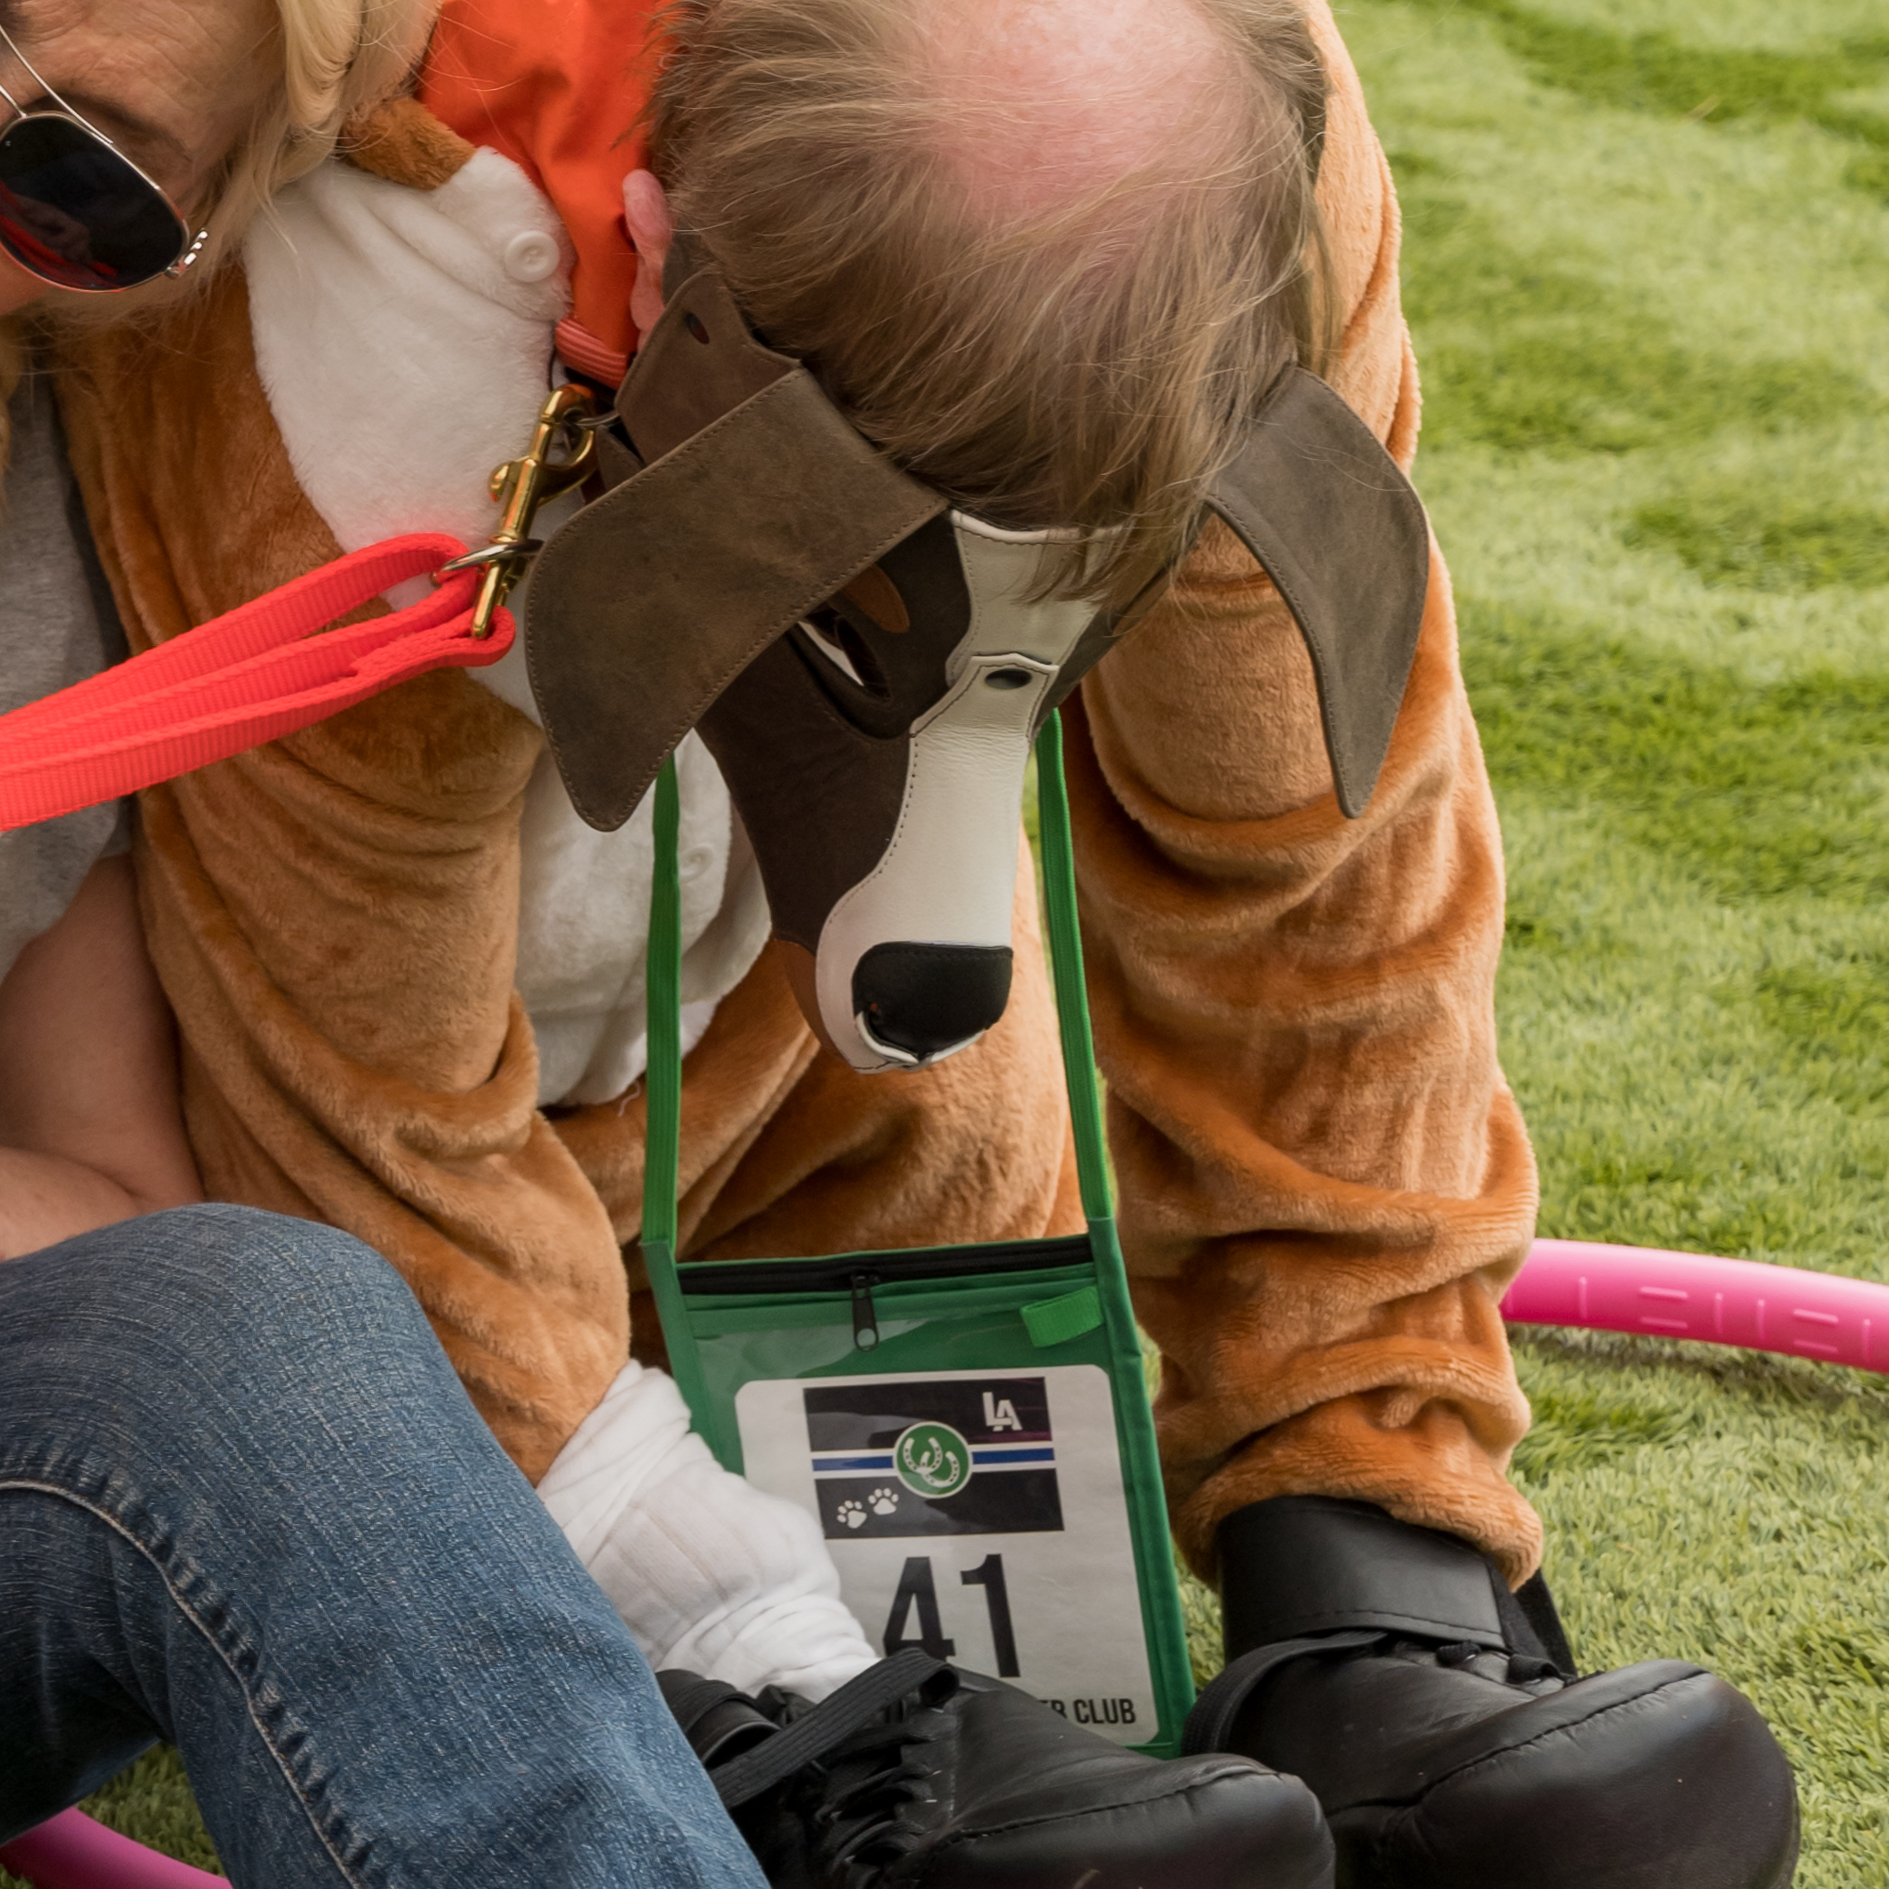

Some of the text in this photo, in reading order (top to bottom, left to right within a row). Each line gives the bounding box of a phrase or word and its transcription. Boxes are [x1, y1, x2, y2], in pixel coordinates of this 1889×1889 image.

[982, 1391, 1022, 1431] LA
[882, 1553, 1021, 1678] 41
[1073, 1698, 1137, 1724] CLUB
